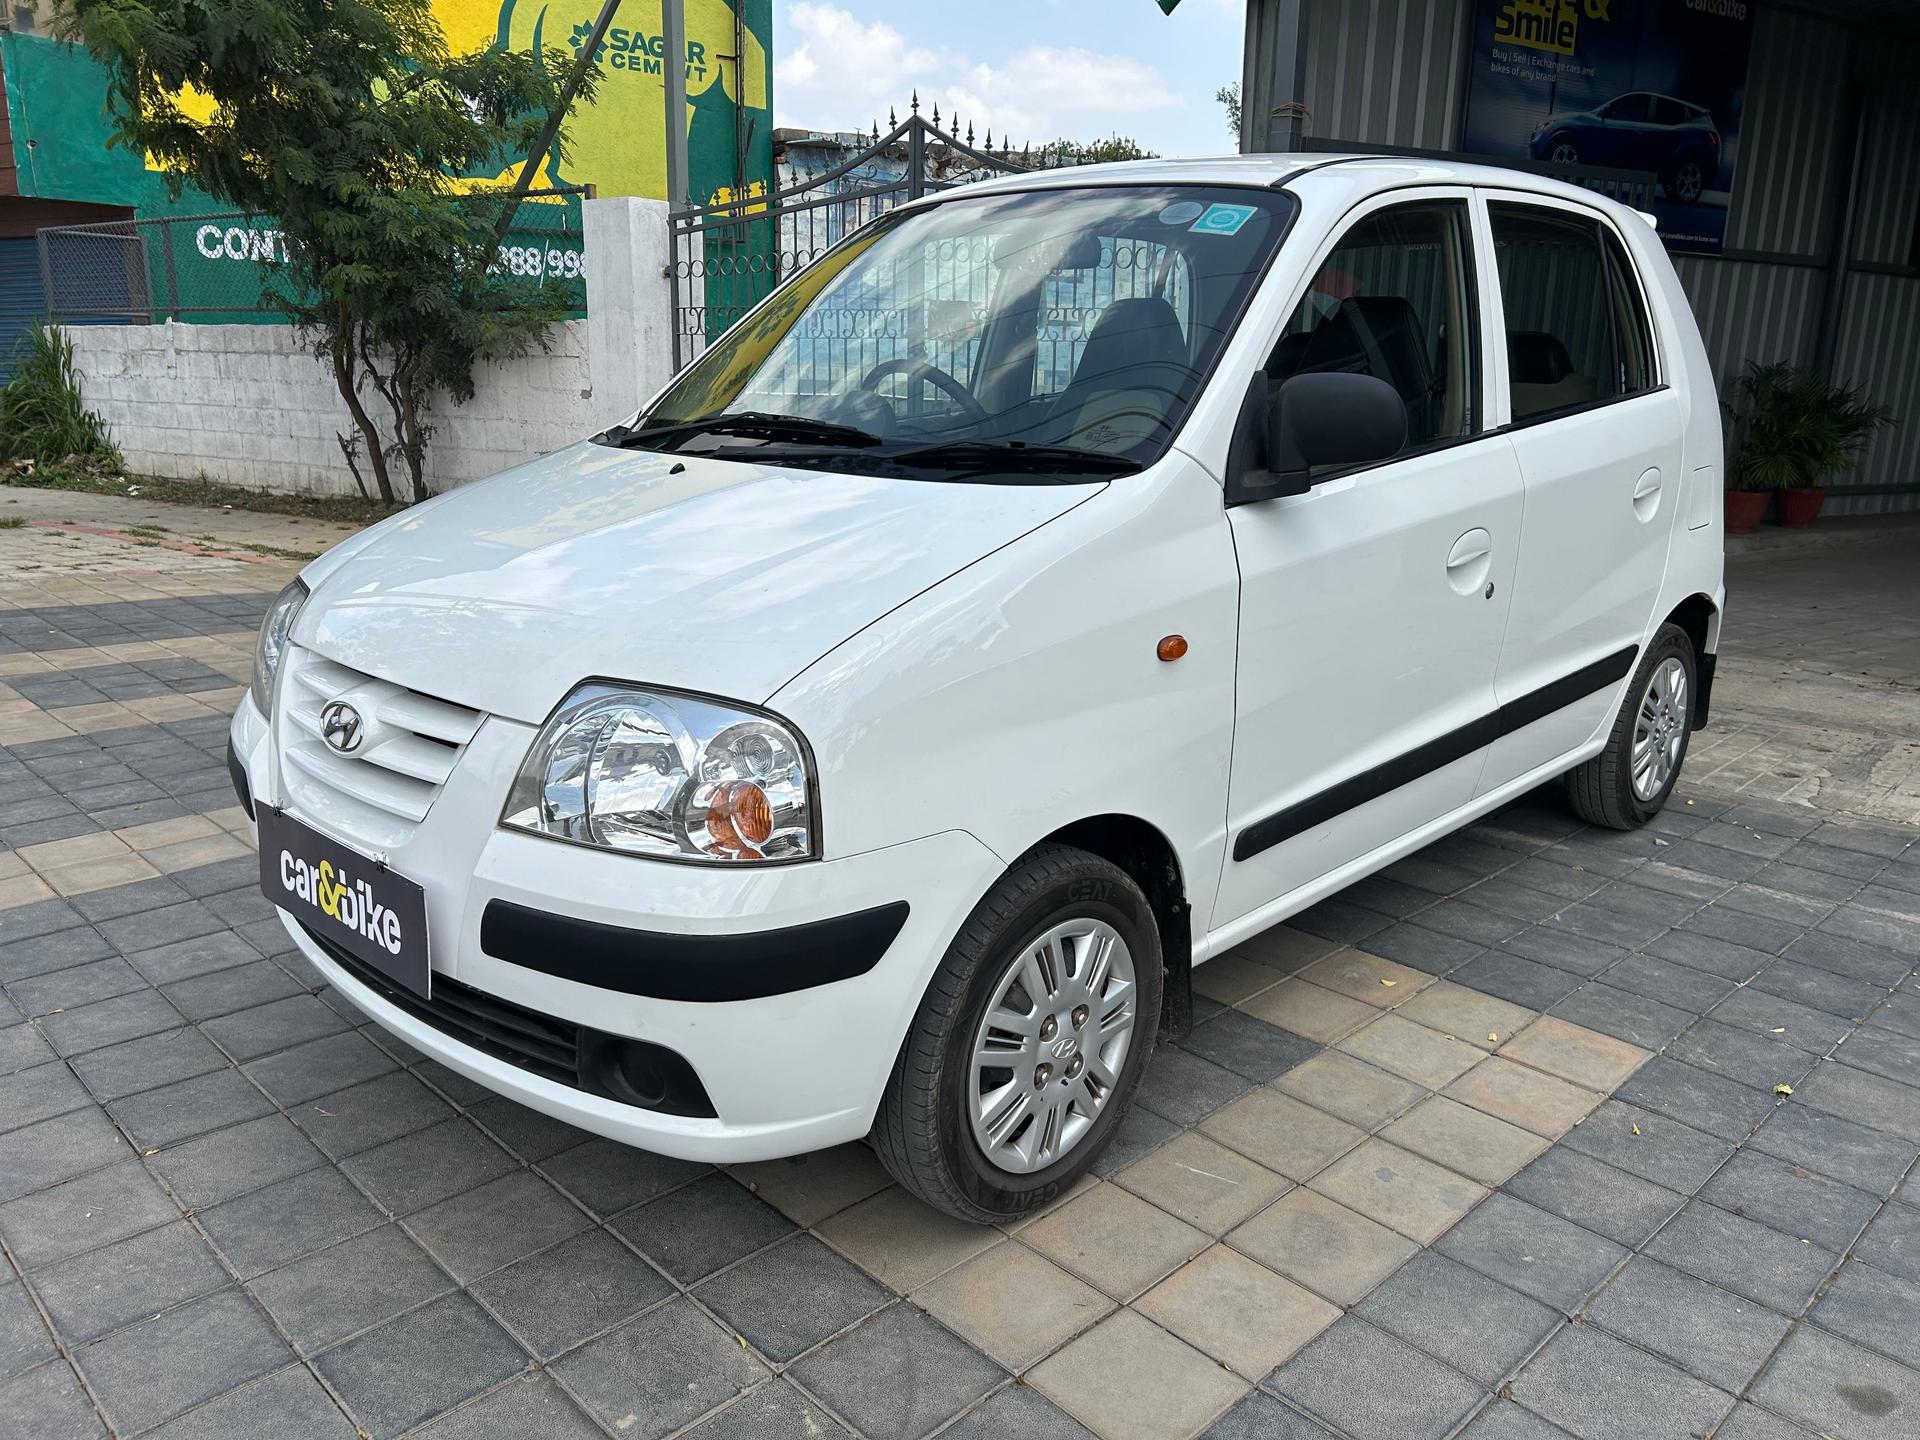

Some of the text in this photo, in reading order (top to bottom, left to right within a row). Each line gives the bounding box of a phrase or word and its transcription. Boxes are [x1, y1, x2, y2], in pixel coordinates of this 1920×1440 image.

[1495, 1, 1574, 48] Smile
[609, 28, 706, 65] SAGR
[610, 52, 707, 82] CEMT
[1490, 62, 1557, 82] bikes of any brand
[1492, 48, 1508, 63] Buy
[1513, 52, 1527, 63] Sell
[1531, 56, 1565, 73] Exchange
[1566, 64, 1581, 73] cars
[1582, 66, 1595, 77] and
[280, 849, 402, 955] car&bike
[1067, 879, 1113, 902] CEAT
